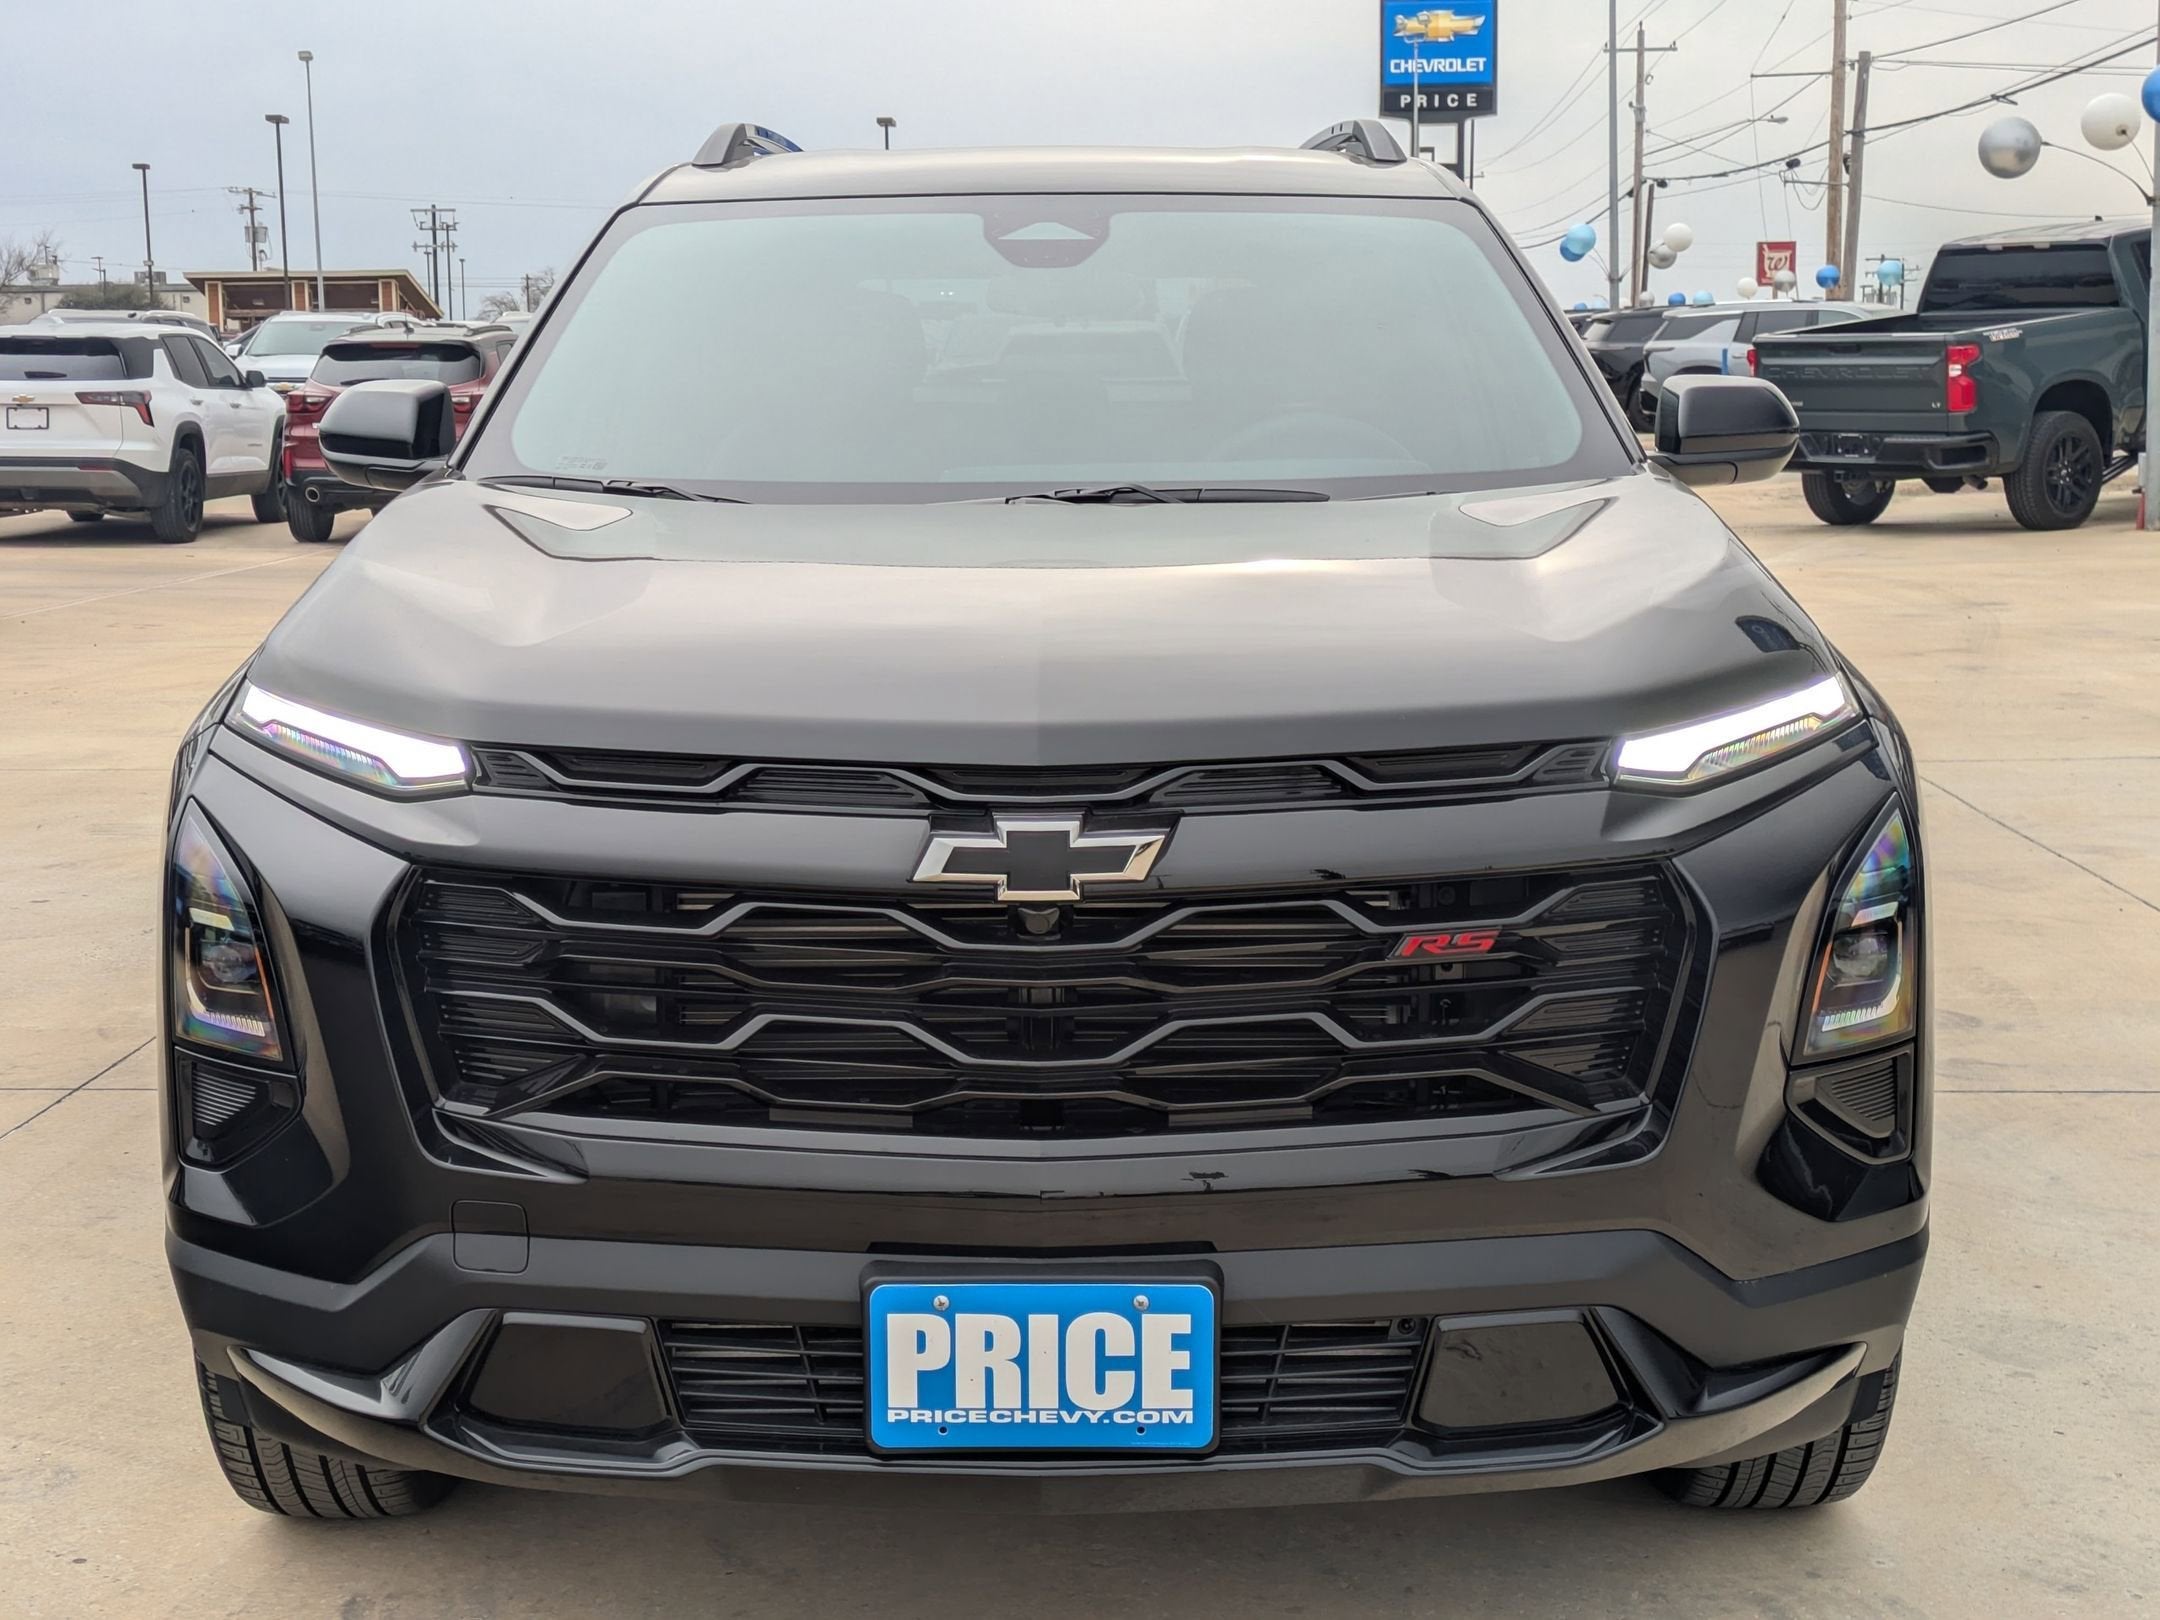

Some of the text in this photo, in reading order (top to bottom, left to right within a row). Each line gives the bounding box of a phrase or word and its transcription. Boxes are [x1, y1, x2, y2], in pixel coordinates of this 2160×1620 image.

[1390, 57, 1487, 74] CHEVROLET
[1400, 93, 1478, 108] PRICE
[1400, 928, 1500, 957] RS
[886, 1312, 1194, 1411] PRICE
[887, 1410, 1194, 1424] PRICECHEVY.COM
